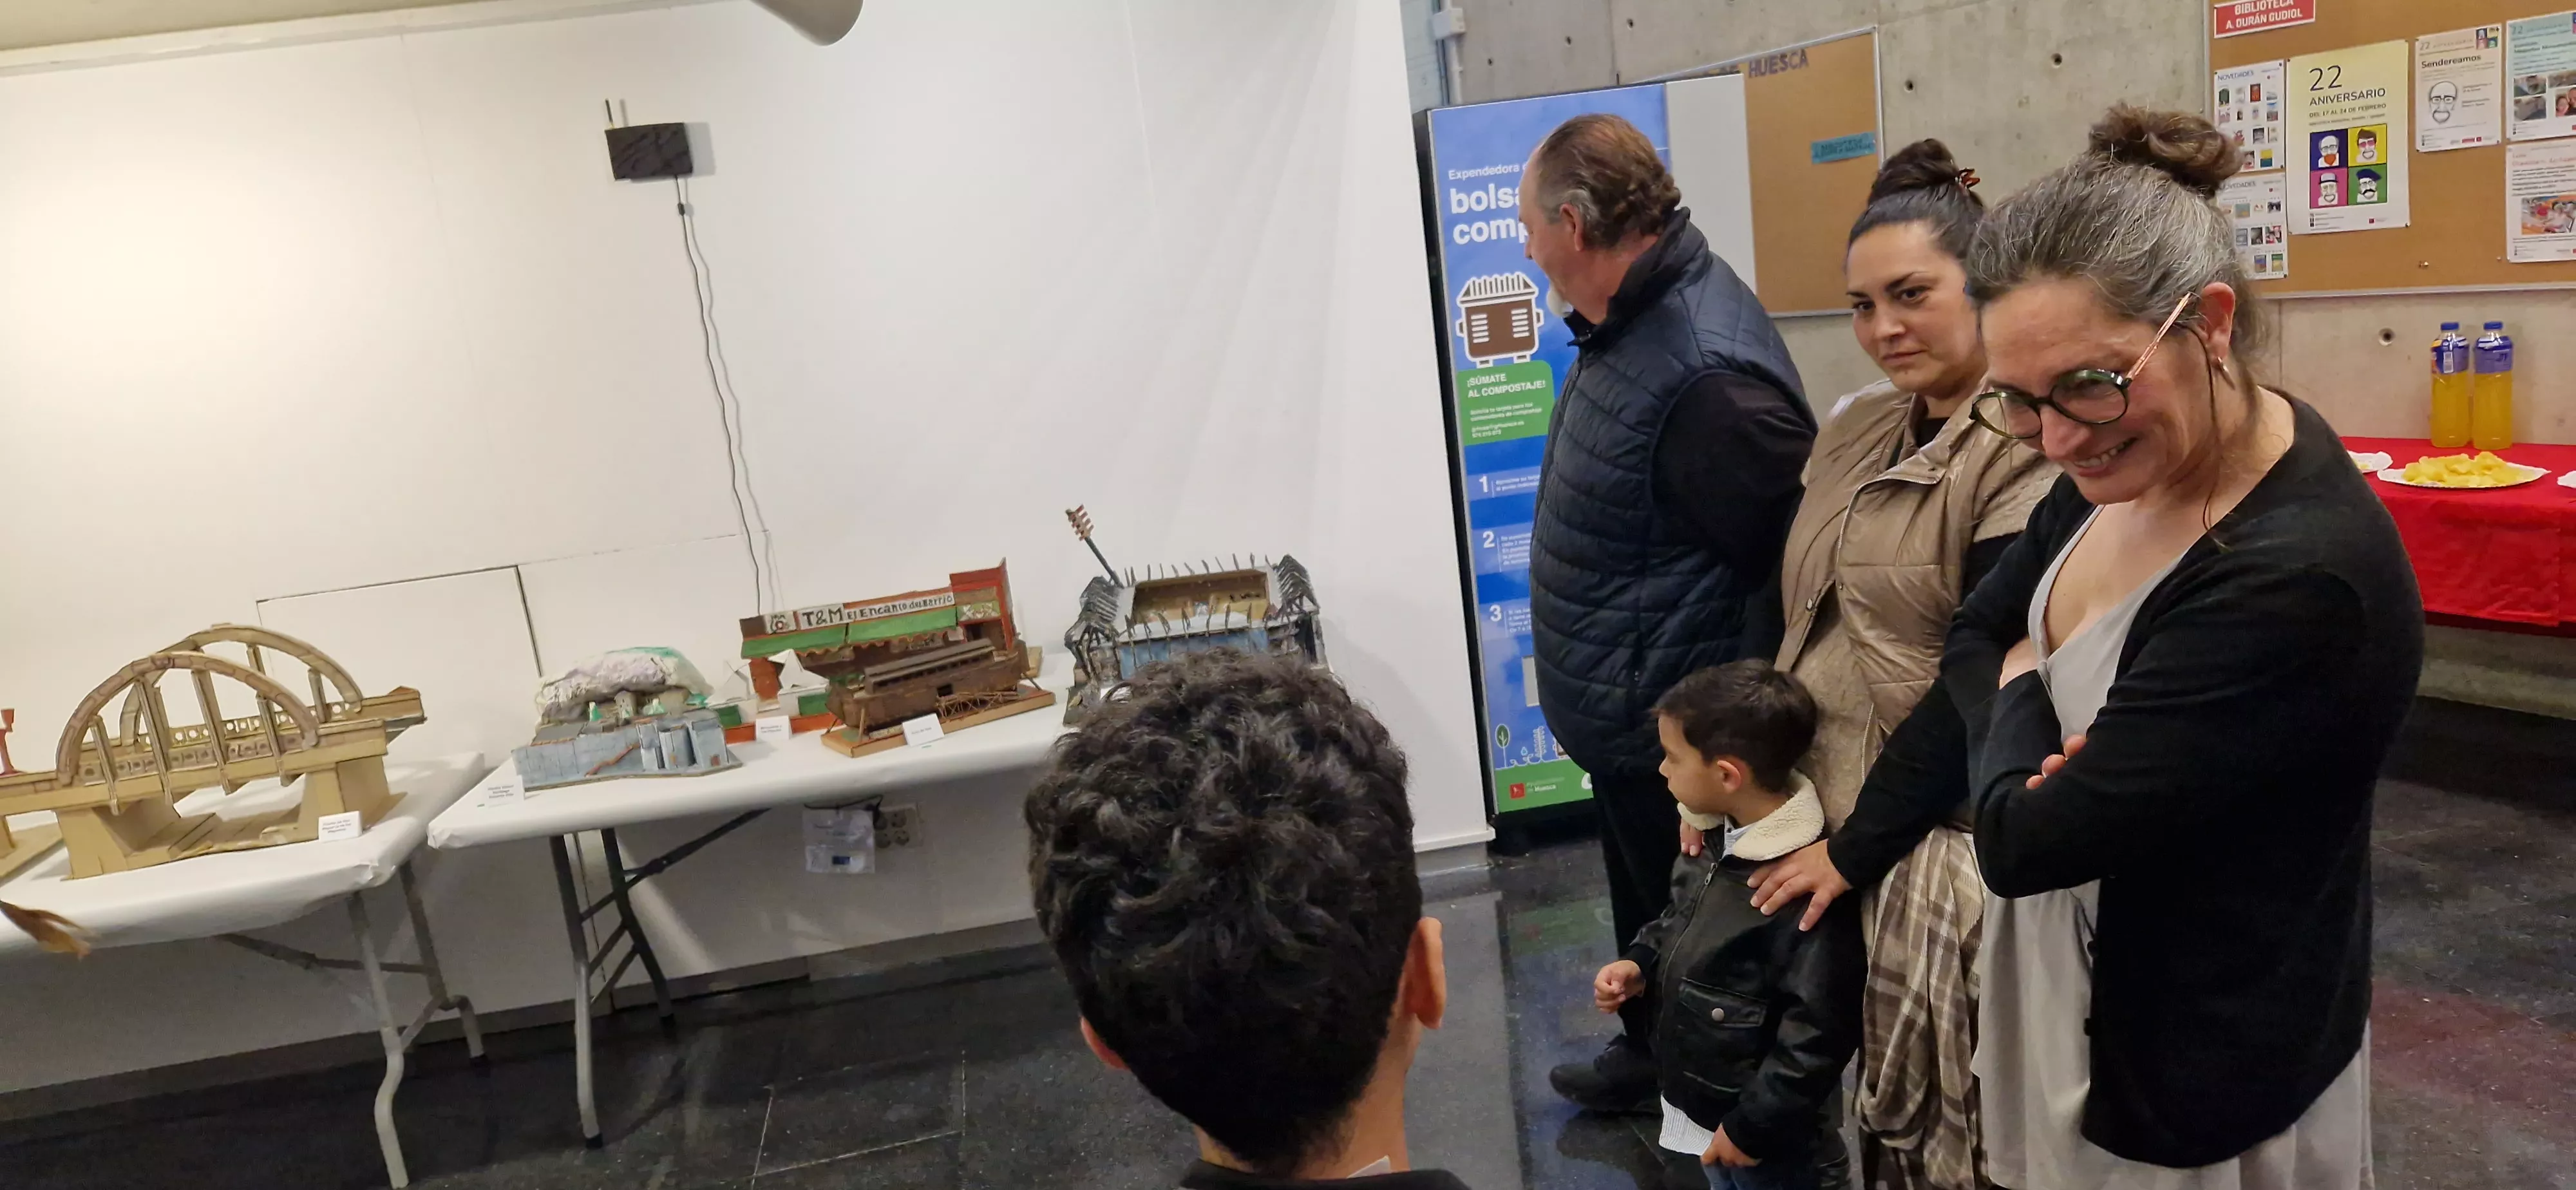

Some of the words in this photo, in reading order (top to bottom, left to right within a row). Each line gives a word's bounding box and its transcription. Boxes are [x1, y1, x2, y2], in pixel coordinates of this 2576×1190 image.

[2235, 0, 2294, 15] BIBLIOTECA
[2226, 20, 2234, 30] A.
[2236, 14, 2267, 28] DURÁN
[2269, 8, 2303, 22] GUDIOL
[1748, 48, 1809, 79] HUESCA
[2421, 54, 2481, 69] Sendereamos
[2218, 70, 2254, 81] NOVEDADES
[2309, 65, 2342, 91] 22
[2309, 88, 2386, 106] ANIVERSARIO
[2358, 103, 2386, 111] FEBRERO
[1448, 164, 1520, 181] Expendedora
[1467, 373, 1507, 388] ¡SÚMATE
[1468, 390, 1481, 398] AL
[1482, 380, 1546, 397] COMPOSTAJE!
[1479, 475, 1488, 493] 1
[1482, 531, 1495, 548] 2
[859, 603, 907, 618] Encanto
[922, 594, 953, 609] Barrio
[1490, 605, 1502, 622] 3
[802, 608, 844, 627] T&M
